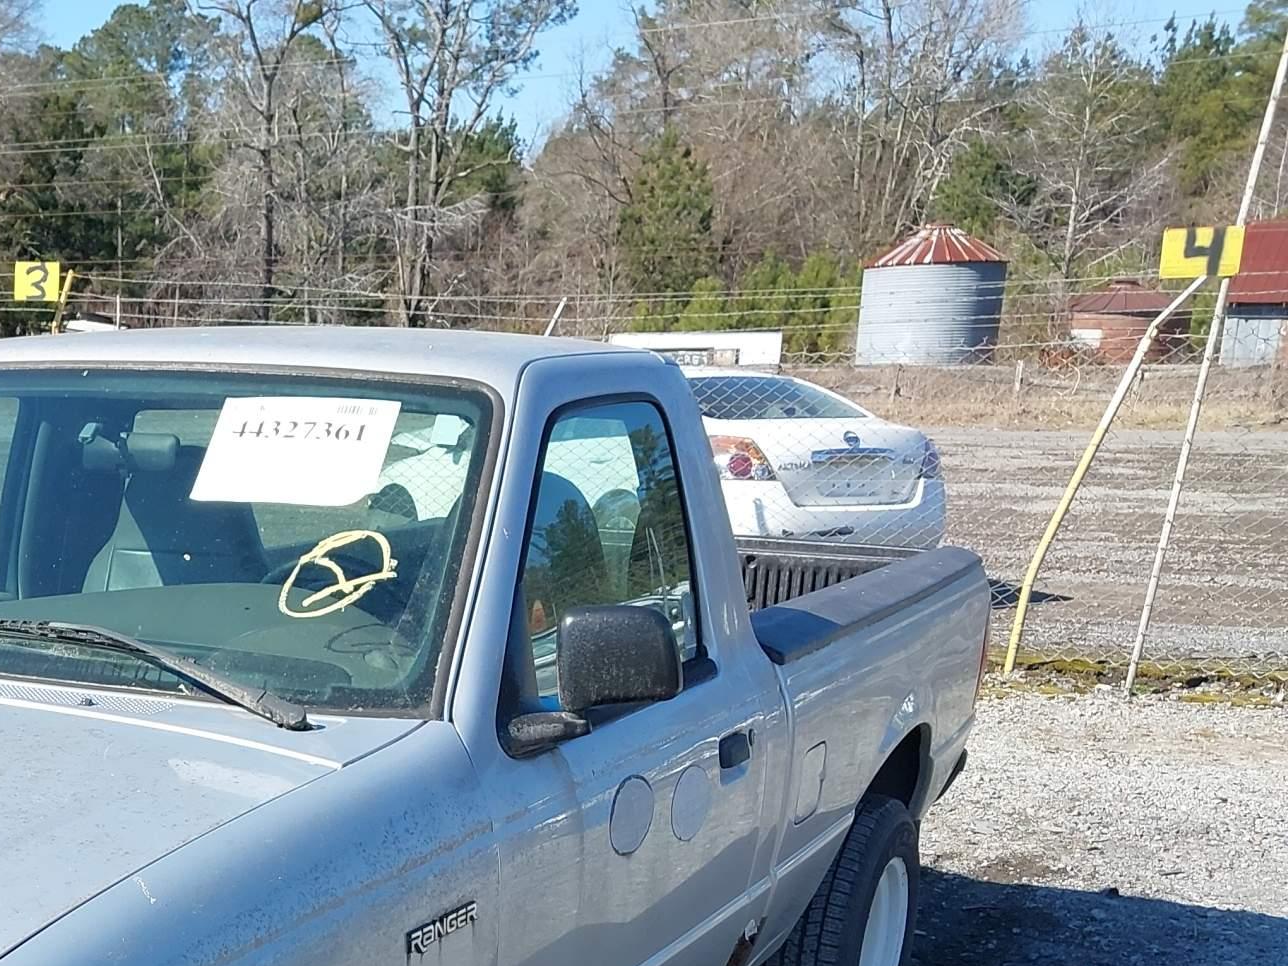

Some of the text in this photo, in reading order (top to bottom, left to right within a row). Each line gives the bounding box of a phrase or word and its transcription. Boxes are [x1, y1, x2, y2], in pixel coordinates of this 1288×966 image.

[1184, 226, 1226, 278] 4
[26, 261, 49, 301] 3
[232, 420, 367, 441] 44327361
[410, 903, 478, 954] RANGER
